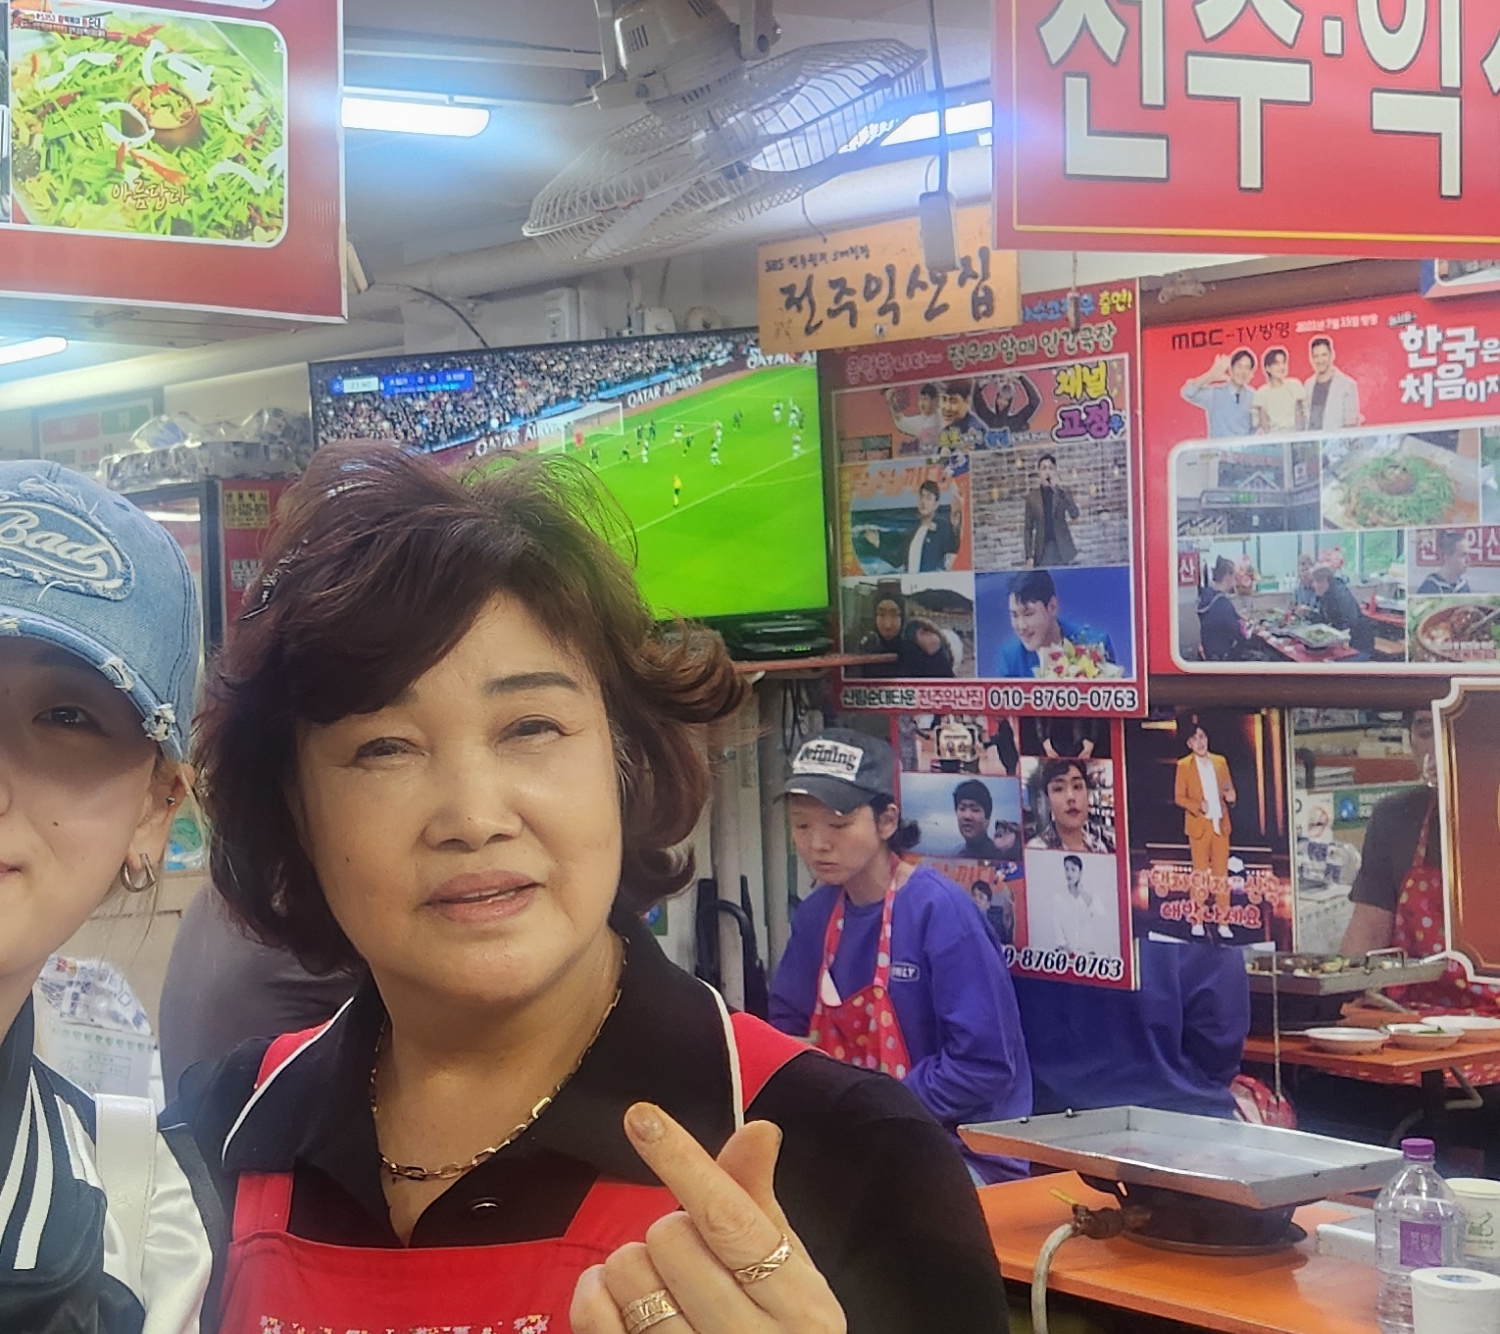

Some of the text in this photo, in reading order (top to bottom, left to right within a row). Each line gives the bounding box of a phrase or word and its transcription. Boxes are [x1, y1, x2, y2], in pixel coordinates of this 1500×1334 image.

[112, 179, 190, 210] 아름답다
[780, 246, 996, 336] 전주익산집
[1099, 288, 1133, 316] 출연!
[1040, 319, 1117, 358] 인간극장
[1400, 323, 1500, 368] 한국은
[627, 373, 702, 408] QATAR AIRWAYS
[474, 427, 520, 457] QATAR
[918, 686, 985, 709] 전주익산집
[989, 688, 1138, 710] 010-8760-0763
